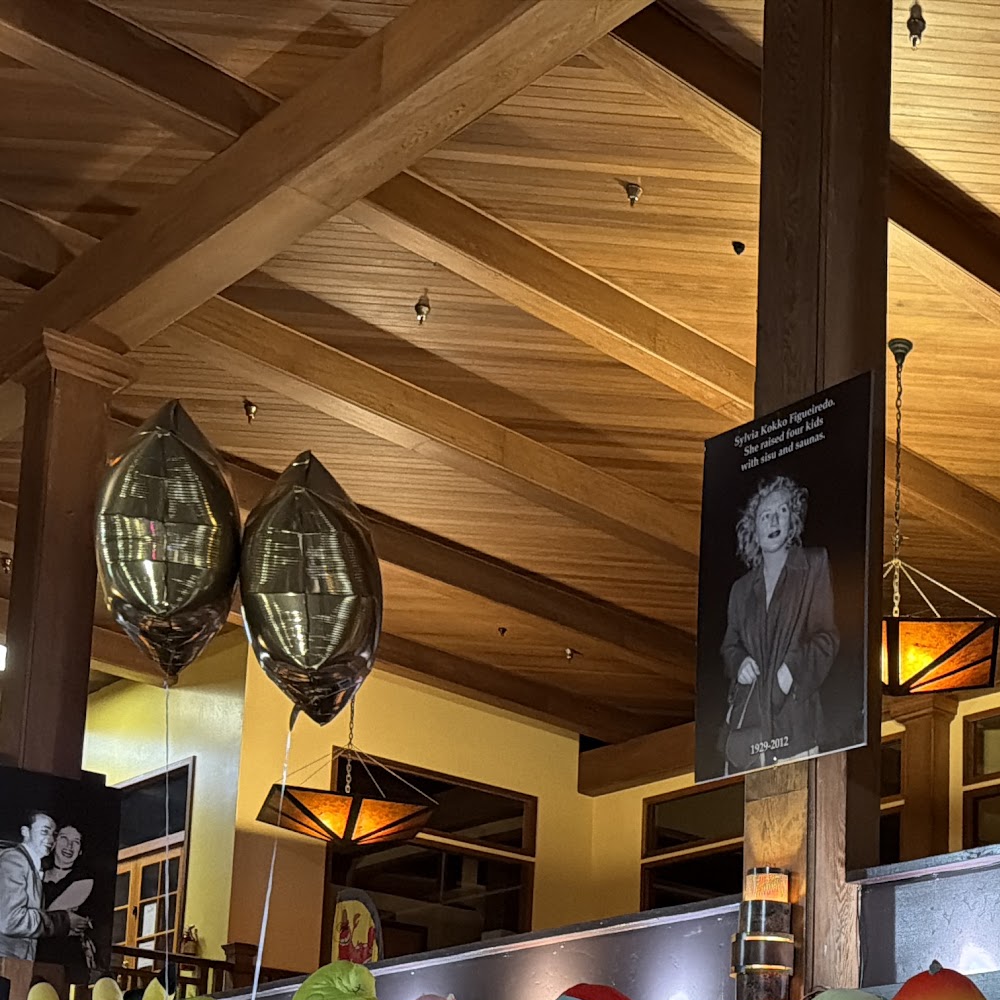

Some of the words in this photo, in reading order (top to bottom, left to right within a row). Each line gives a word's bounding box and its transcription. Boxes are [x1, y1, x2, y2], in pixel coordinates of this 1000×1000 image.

[734, 429, 759, 447] Sylvia
[760, 419, 788, 436] Kokko
[789, 398, 835, 424] Figueiredo.
[744, 444, 759, 456] She
[760, 431, 785, 450] raised
[786, 425, 805, 439] four
[805, 416, 824, 431] kids
[741, 457, 759, 471] with
[760, 451, 777, 464] sisu
[778, 442, 794, 457] and
[795, 431, 826, 450] saunas.
[750, 736, 789, 755] 1929-2012
